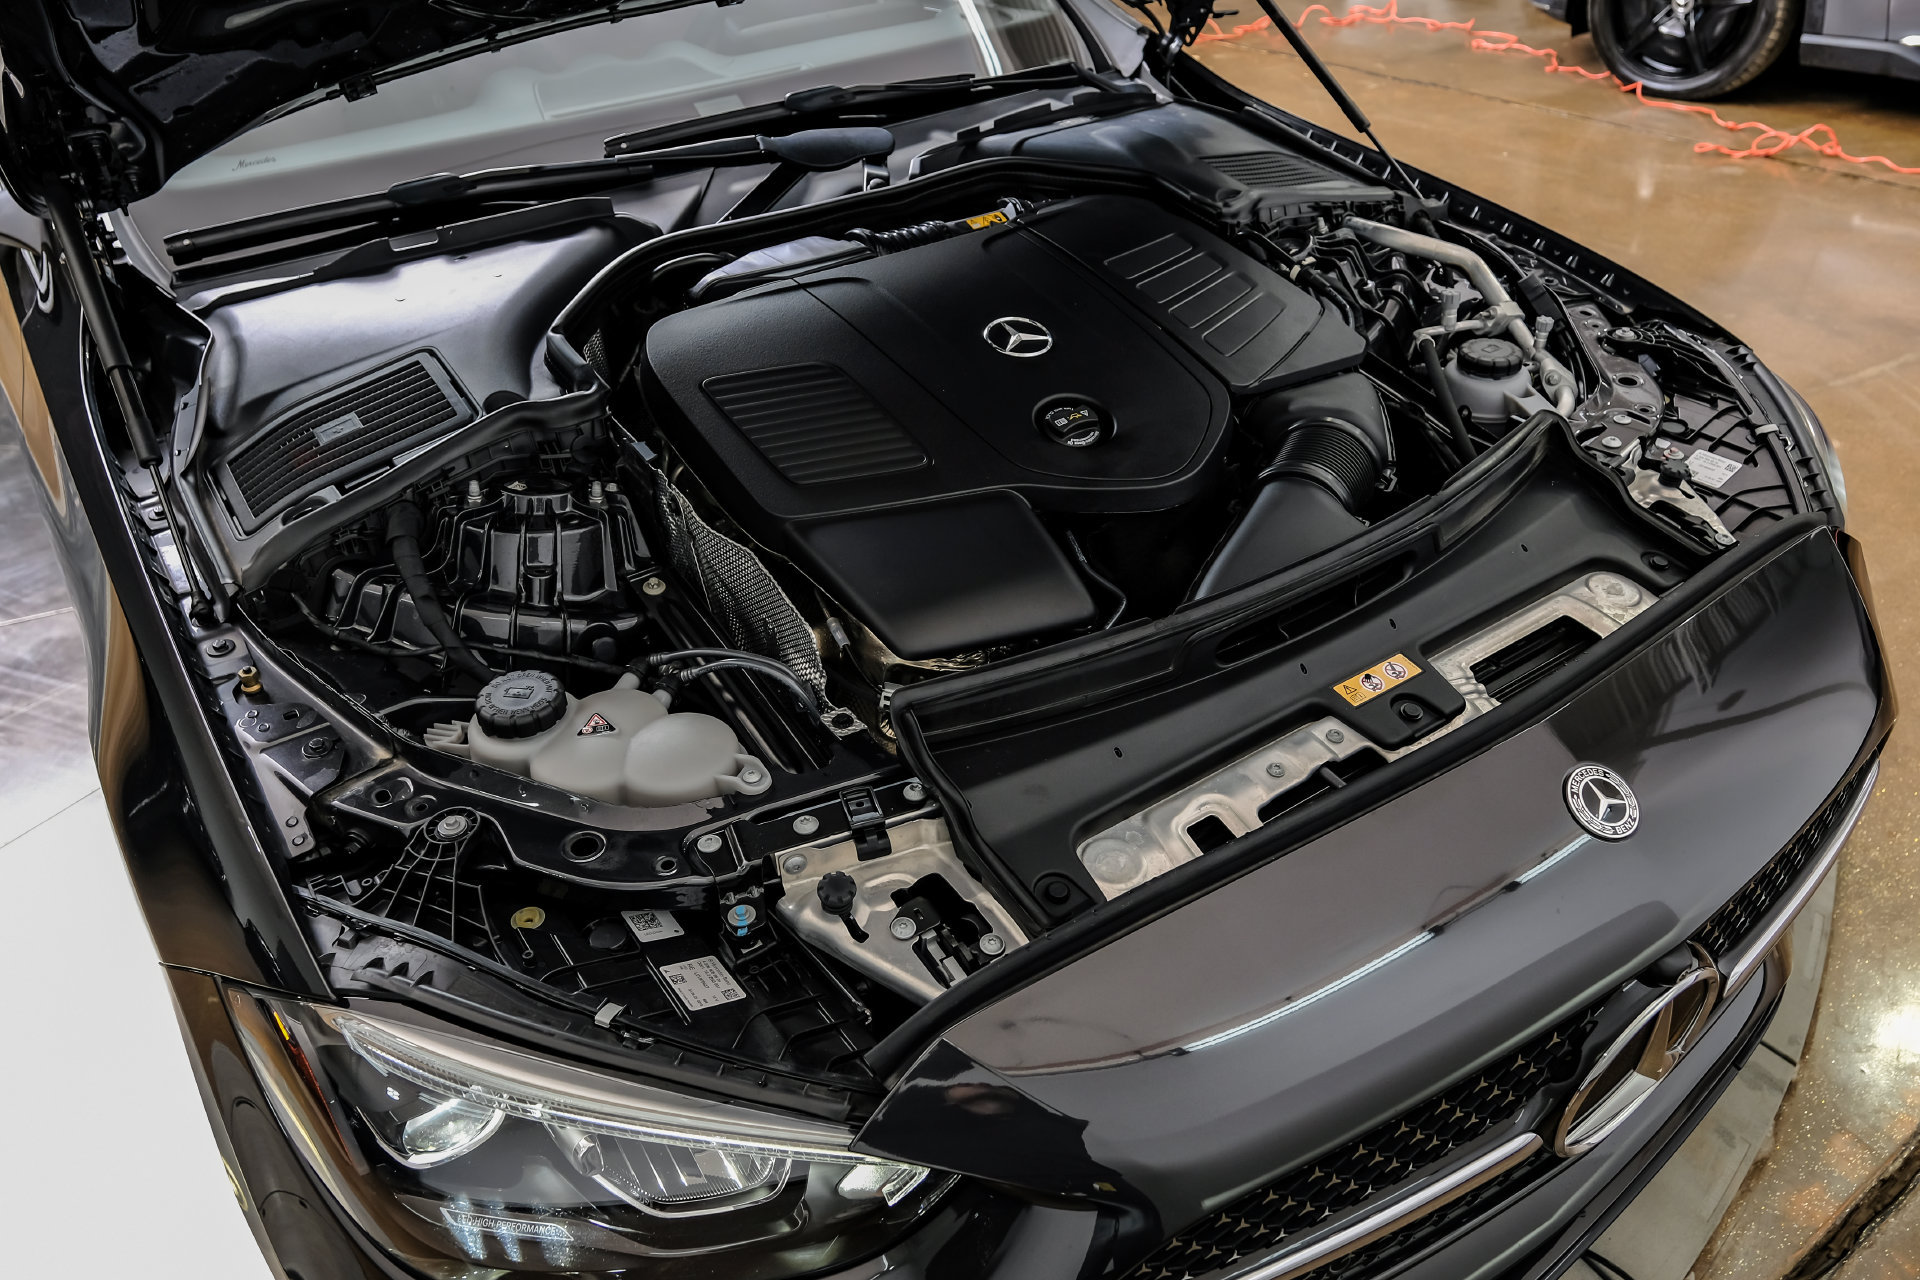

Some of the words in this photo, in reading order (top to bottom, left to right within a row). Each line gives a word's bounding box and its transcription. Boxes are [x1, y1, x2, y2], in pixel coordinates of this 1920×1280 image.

[1571, 768, 1605, 794] MERCEDES
[1615, 818, 1636, 834] BENZ
[473, 1217, 494, 1227] HIGH
[496, 1220, 558, 1236] PERFORMANCE
